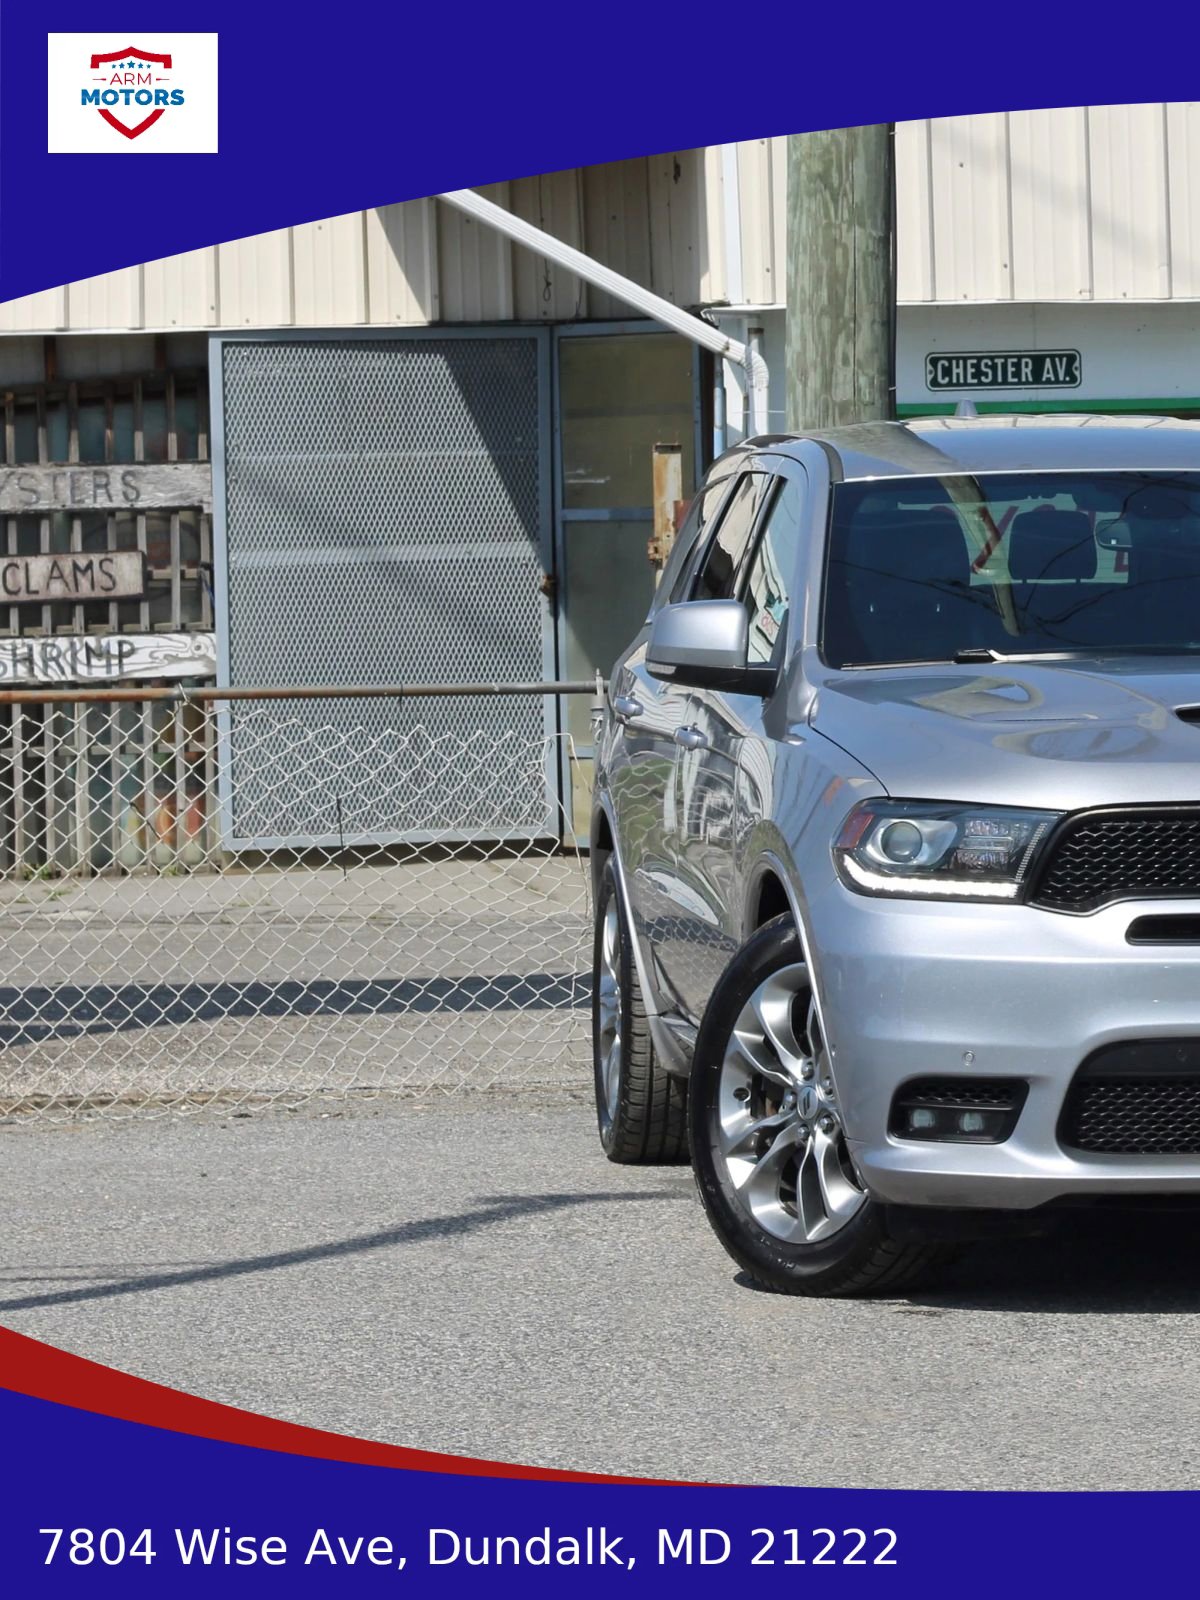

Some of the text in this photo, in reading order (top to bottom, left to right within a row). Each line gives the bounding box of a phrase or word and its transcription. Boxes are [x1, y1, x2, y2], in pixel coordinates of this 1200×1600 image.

[937, 357, 1070, 384] CHESTER AV.
[2, 557, 117, 596] CLAMS
